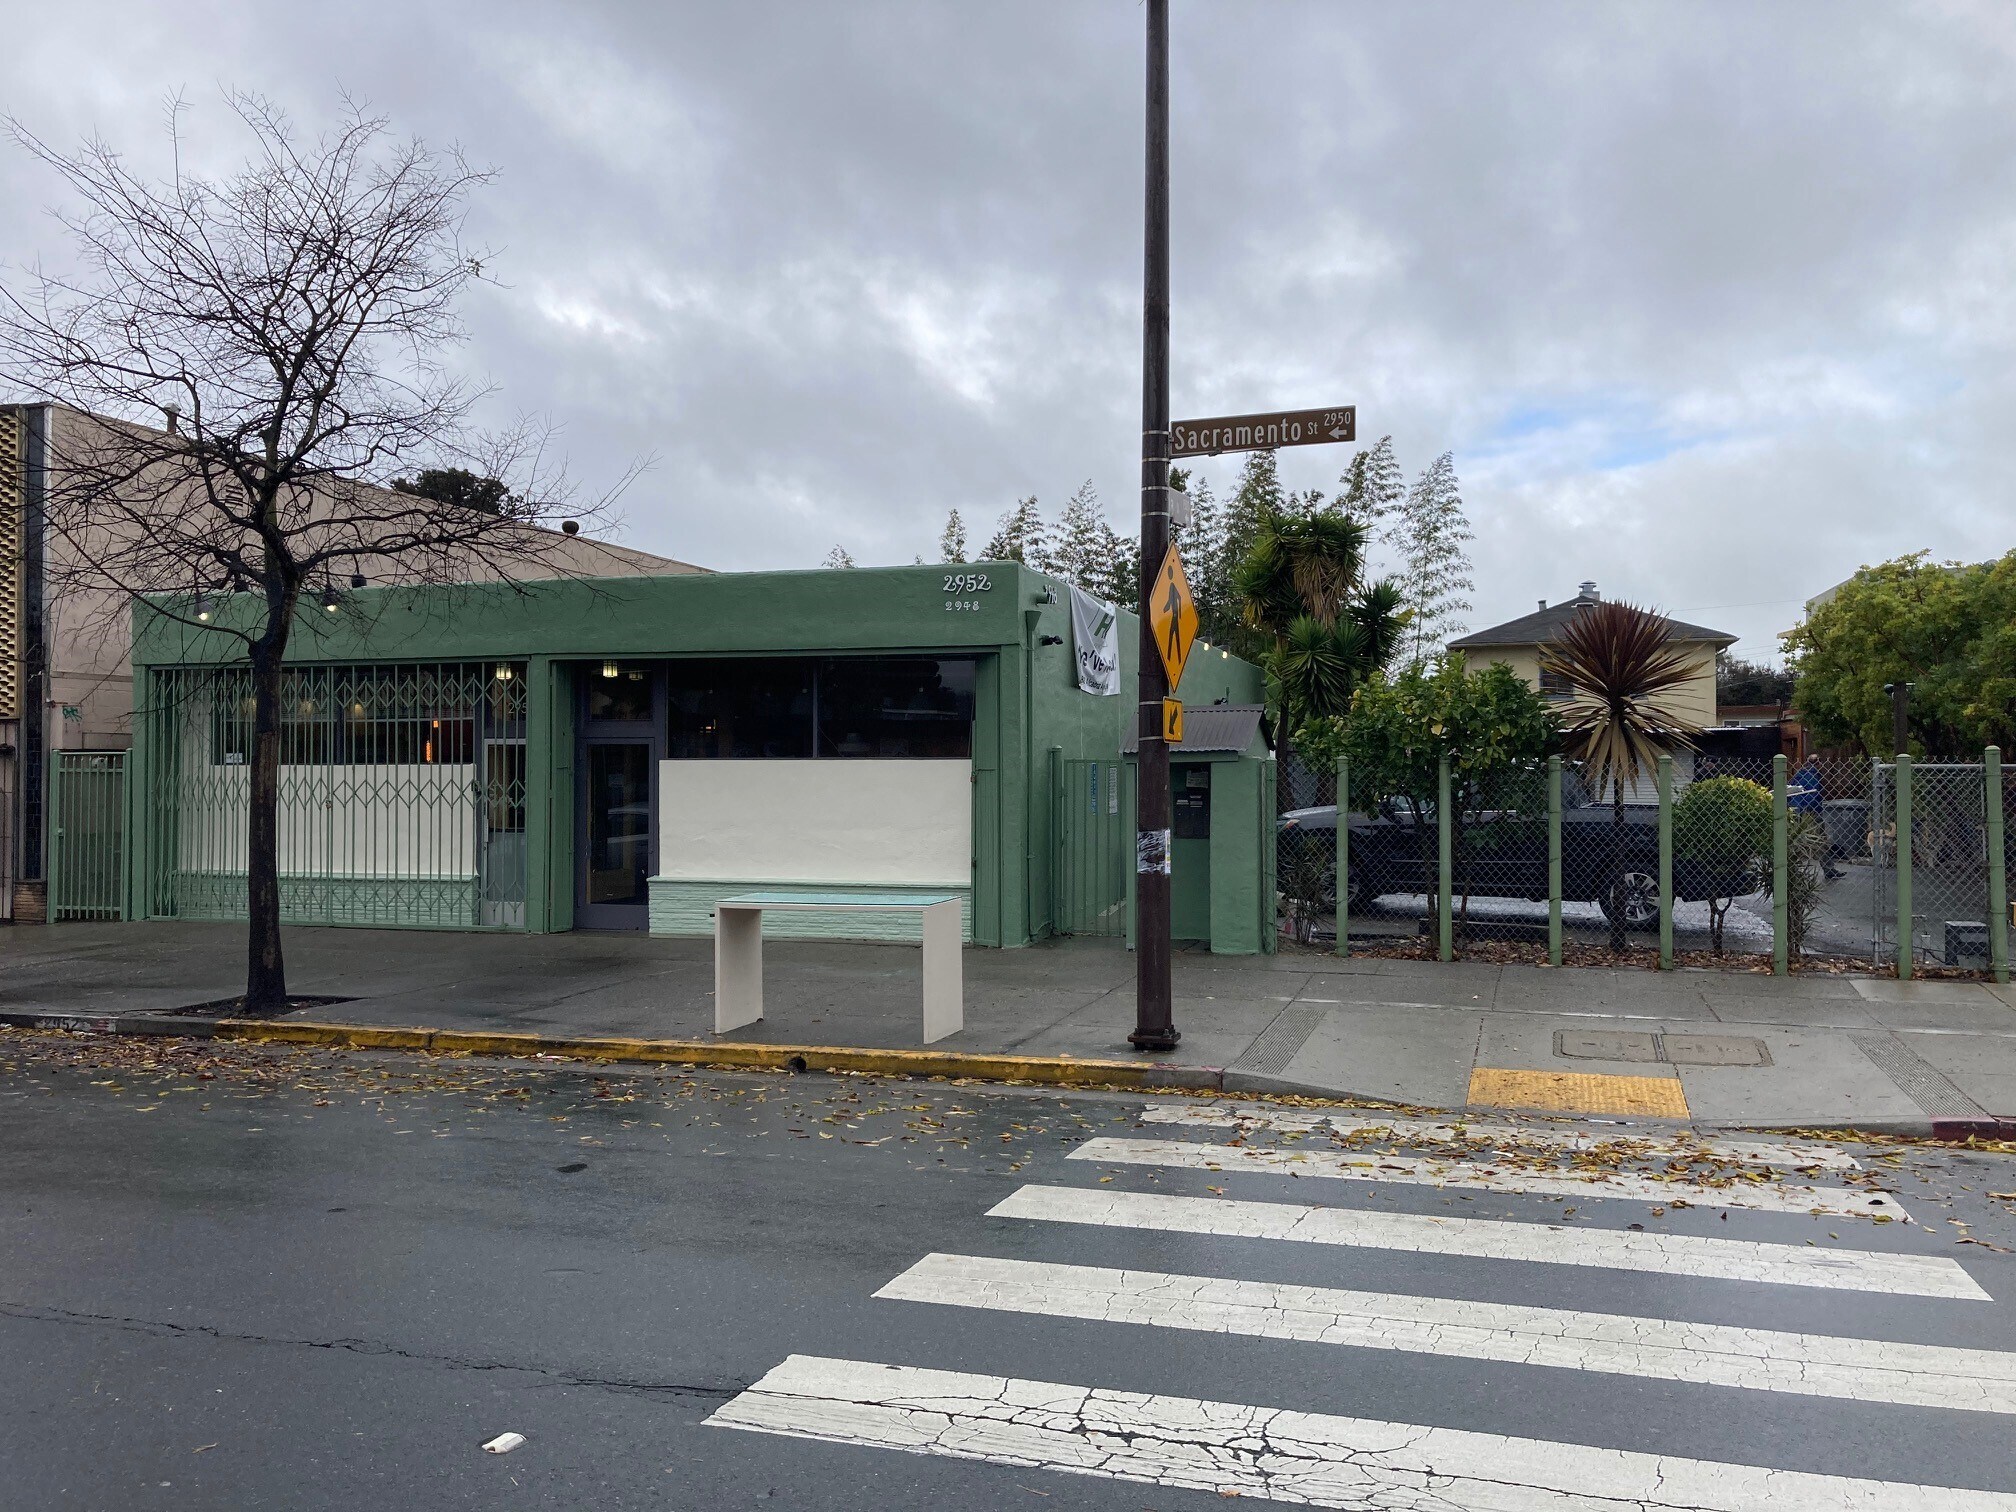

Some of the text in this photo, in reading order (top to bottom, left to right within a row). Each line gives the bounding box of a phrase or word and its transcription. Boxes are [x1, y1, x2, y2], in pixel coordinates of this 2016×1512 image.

[1174, 411, 1351, 450] Sacramento St 2950
[943, 574, 992, 595] 2952
[945, 600, 980, 611] 2948
